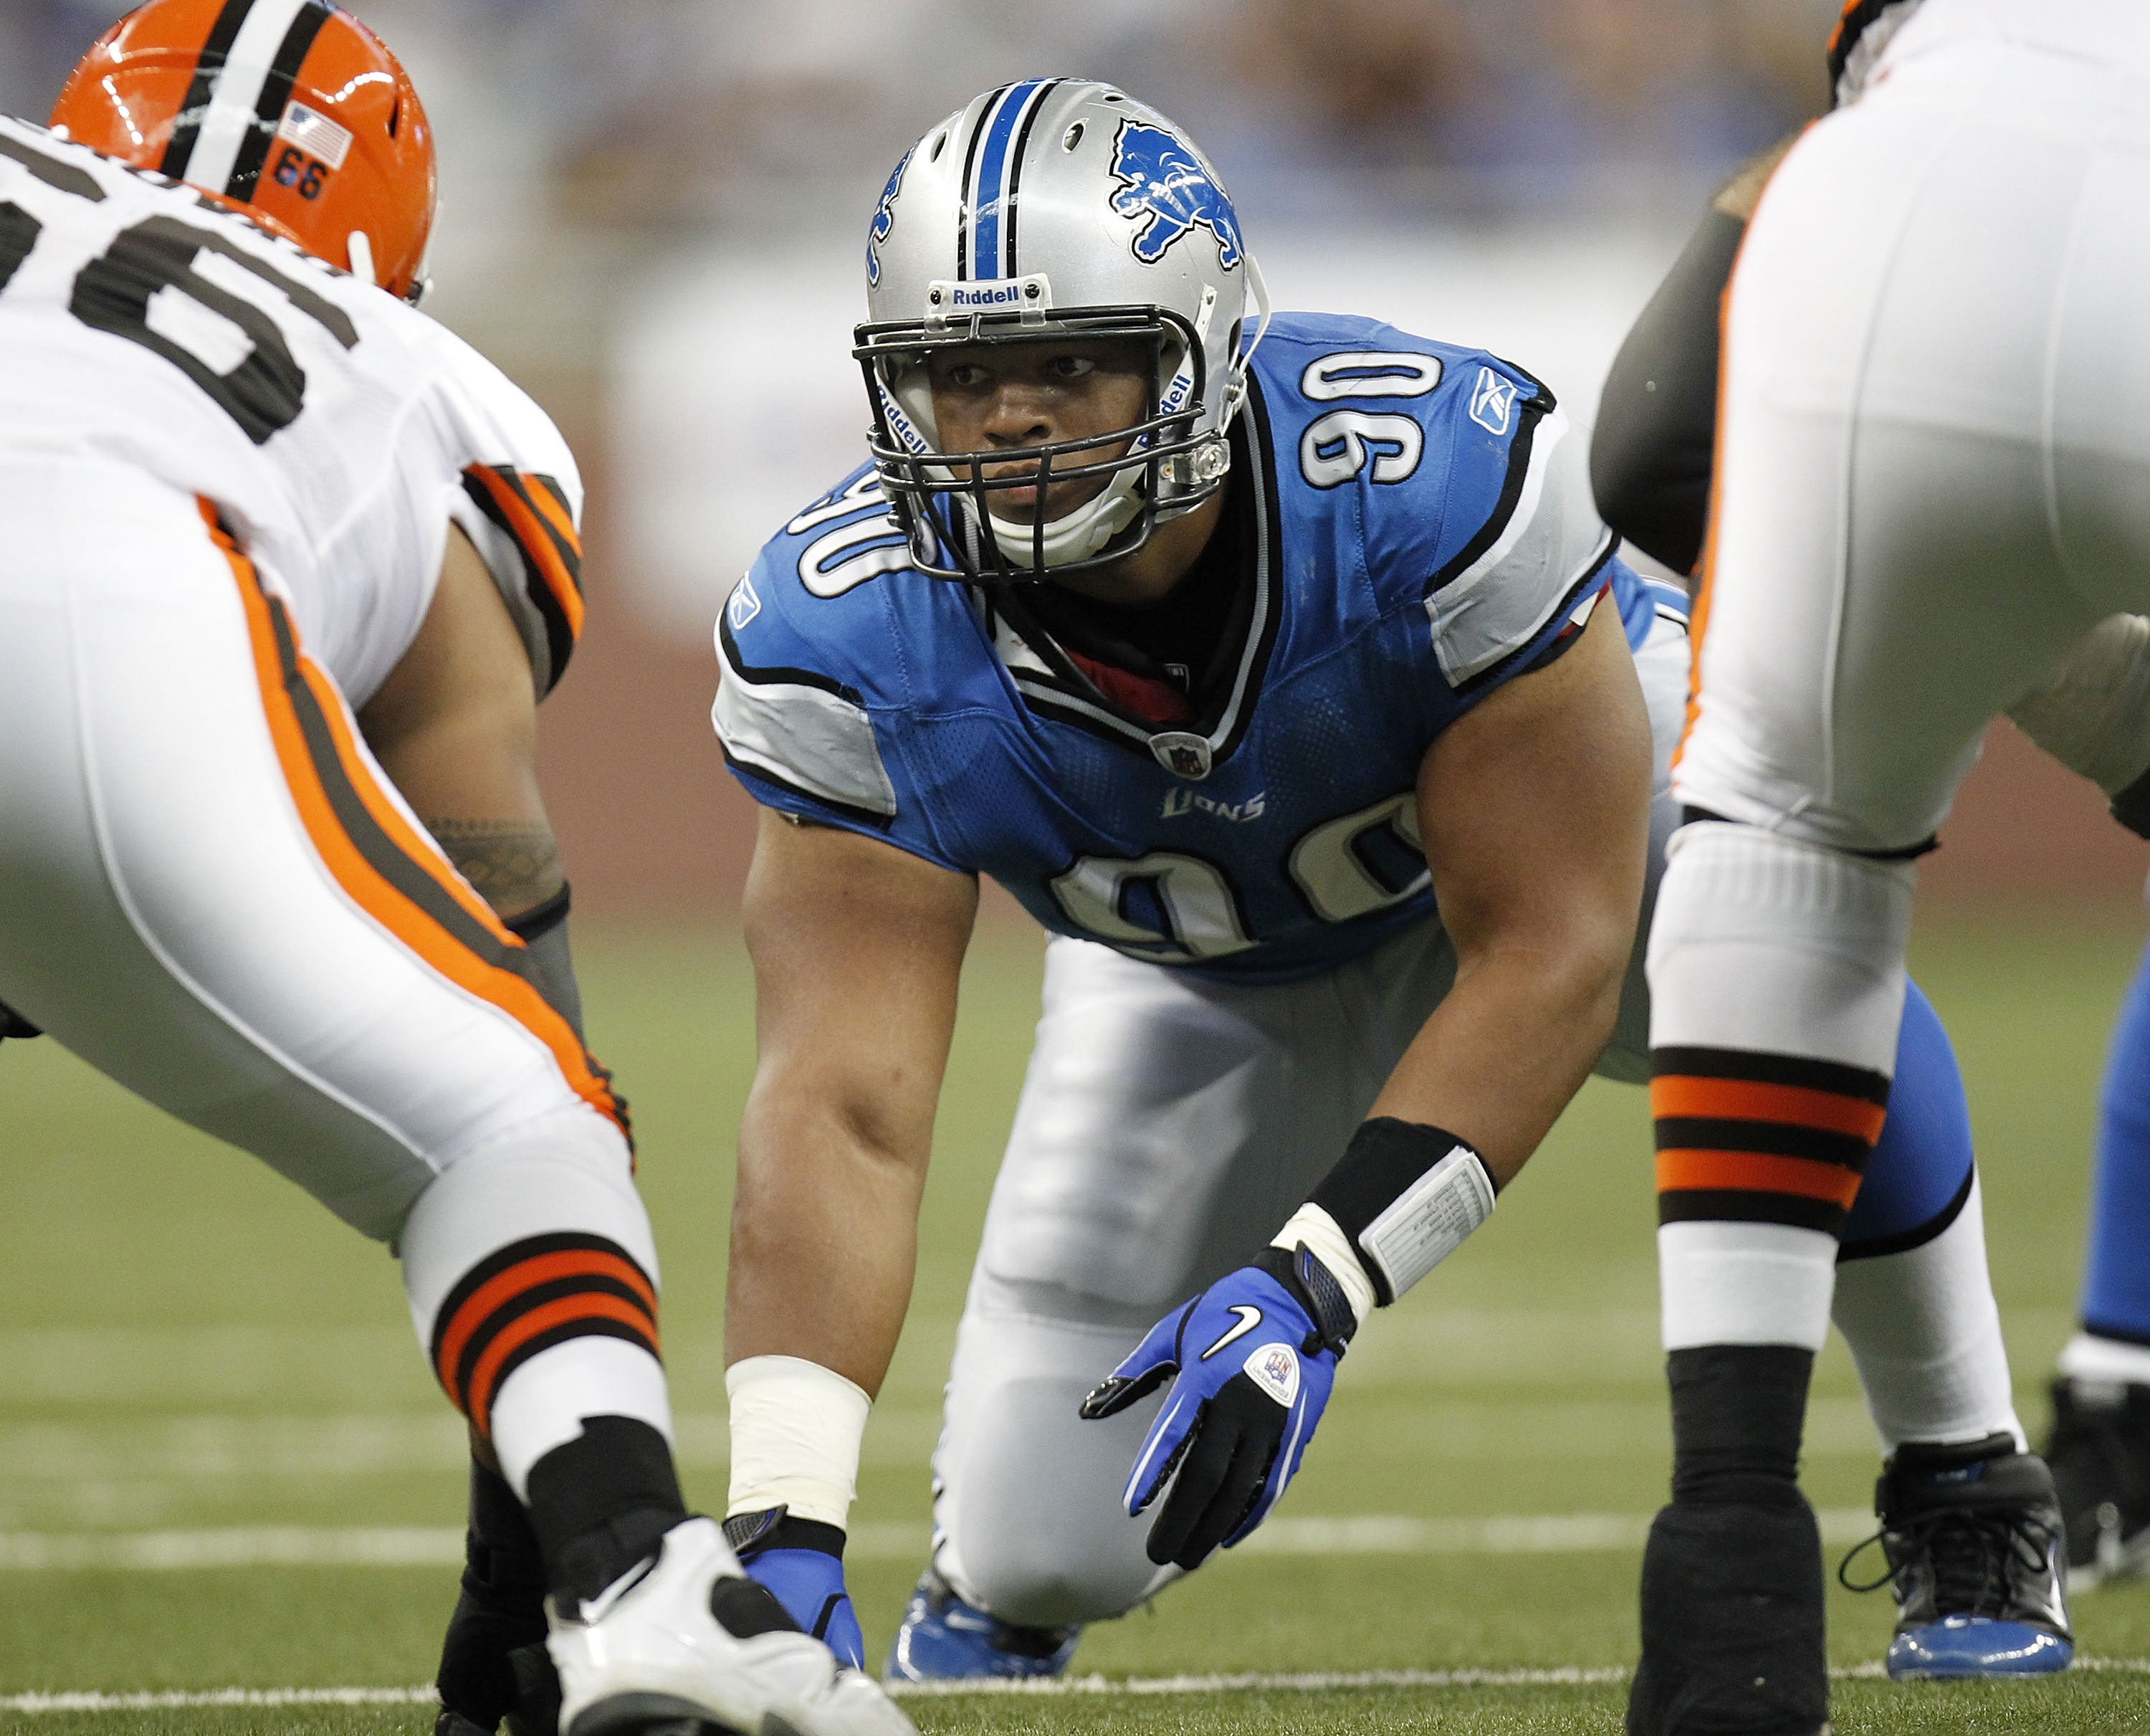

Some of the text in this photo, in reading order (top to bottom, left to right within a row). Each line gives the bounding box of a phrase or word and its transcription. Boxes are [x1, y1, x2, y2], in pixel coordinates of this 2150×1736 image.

[274, 147, 328, 201] 66
[953, 285, 1019, 305] Riddell
[1299, 350, 1444, 490] 90
